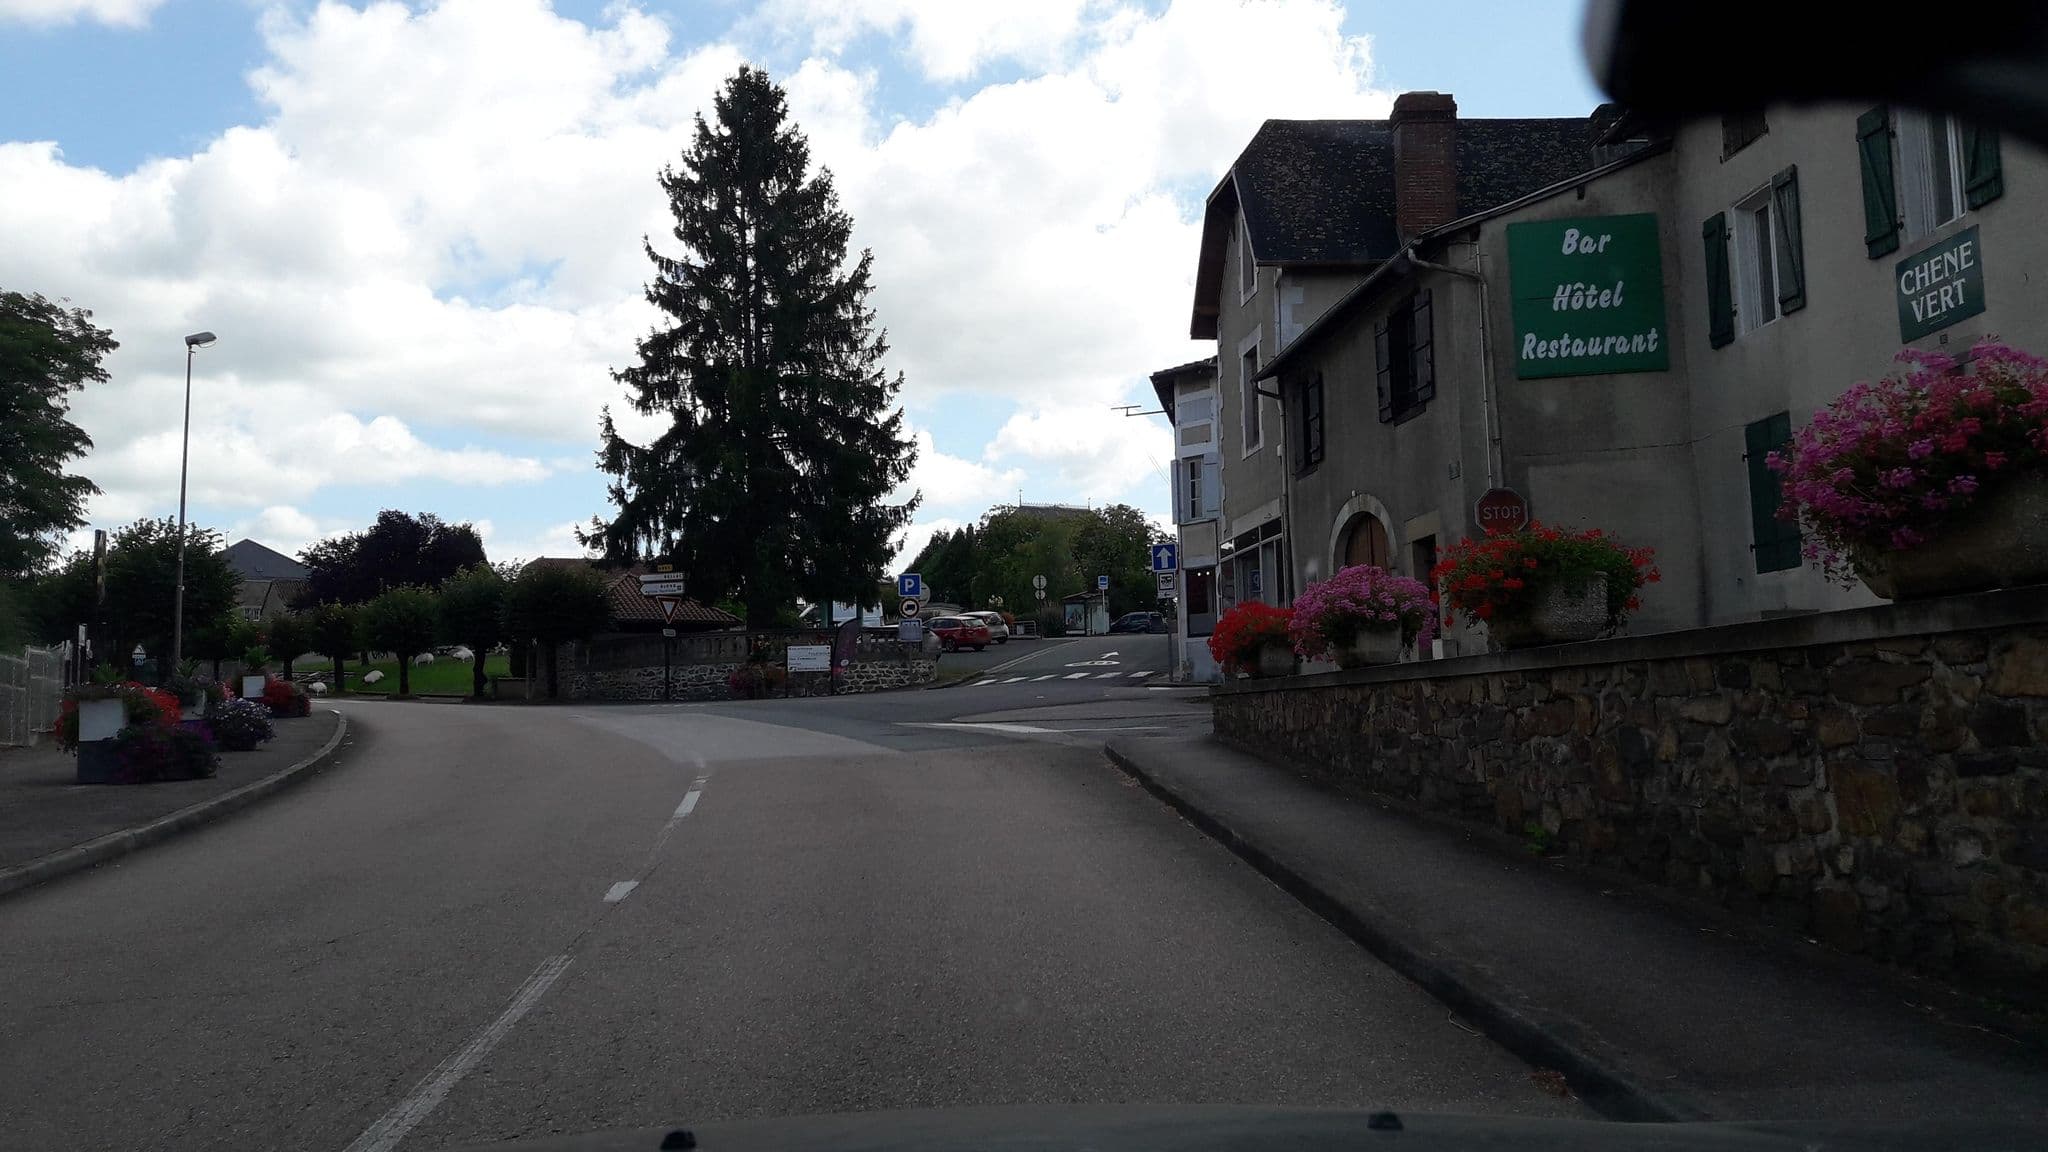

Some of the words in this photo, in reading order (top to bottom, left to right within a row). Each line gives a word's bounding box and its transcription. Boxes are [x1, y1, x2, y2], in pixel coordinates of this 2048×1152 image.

[1562, 228, 1611, 255] Bar
[1900, 240, 1974, 296] CHENE
[1552, 280, 1624, 311] Hôtel
[1910, 278, 1967, 323] VERT
[1521, 327, 1659, 360] Restaurant
[1482, 505, 1521, 520] STOP
[904, 578, 915, 592] P
